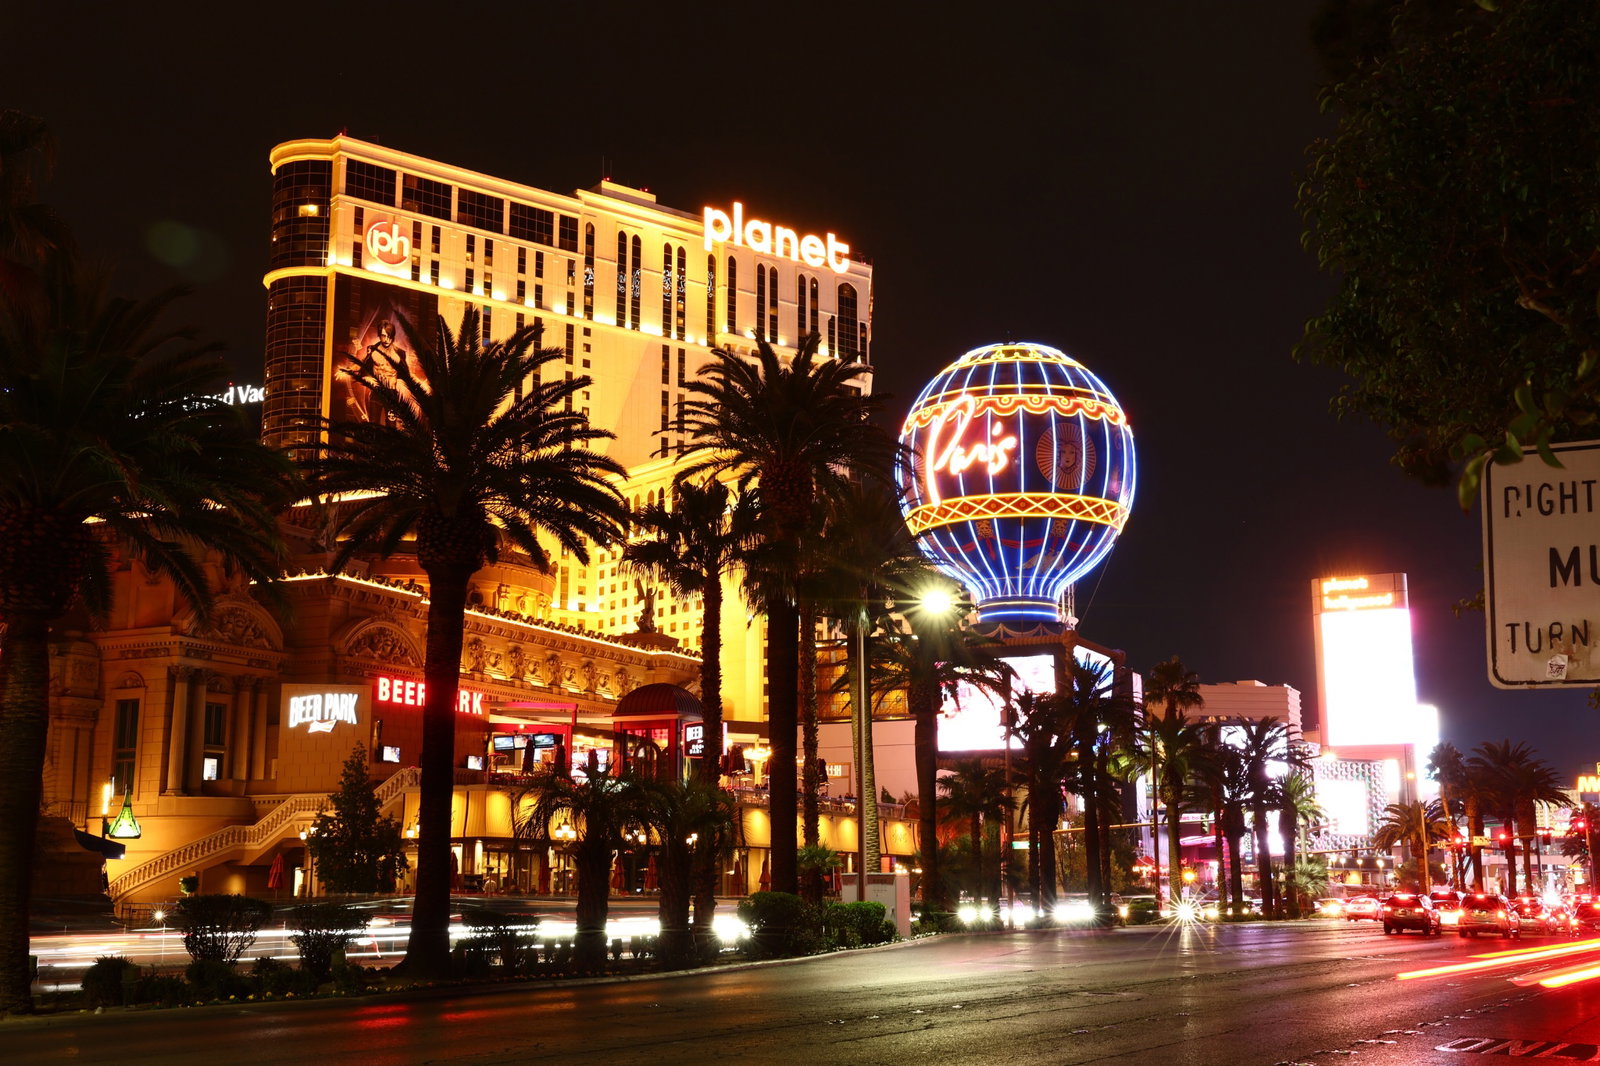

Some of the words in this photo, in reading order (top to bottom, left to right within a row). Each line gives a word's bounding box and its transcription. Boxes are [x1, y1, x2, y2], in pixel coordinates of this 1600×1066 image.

[372, 223, 410, 258] ph
[704, 202, 850, 274] planet
[926, 394, 1017, 508] Paris
[1504, 480, 1597, 519] RIGHT
[1505, 619, 1589, 654] TURN
[289, 694, 322, 728] BEER
[324, 693, 358, 725] PARK
[378, 677, 425, 706] BEER
[454, 690, 483, 715] RK
